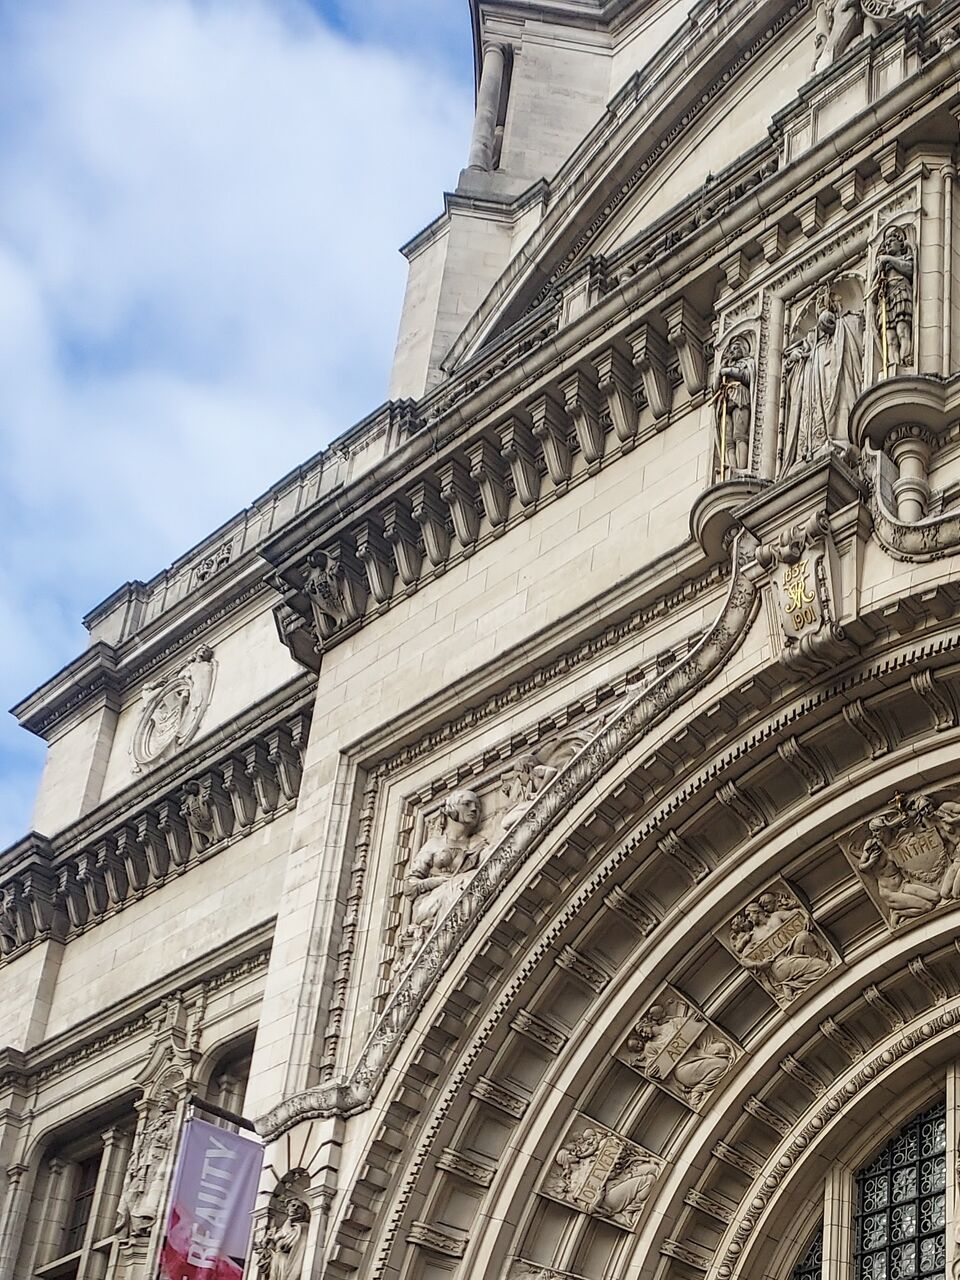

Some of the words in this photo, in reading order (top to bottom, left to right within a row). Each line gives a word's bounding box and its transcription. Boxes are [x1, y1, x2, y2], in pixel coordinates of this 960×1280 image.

[782, 559, 809, 586] 1837
[792, 606, 817, 631] 1901
[667, 1033, 690, 1063] ART
[187, 1136, 237, 1269] BEAUTY
